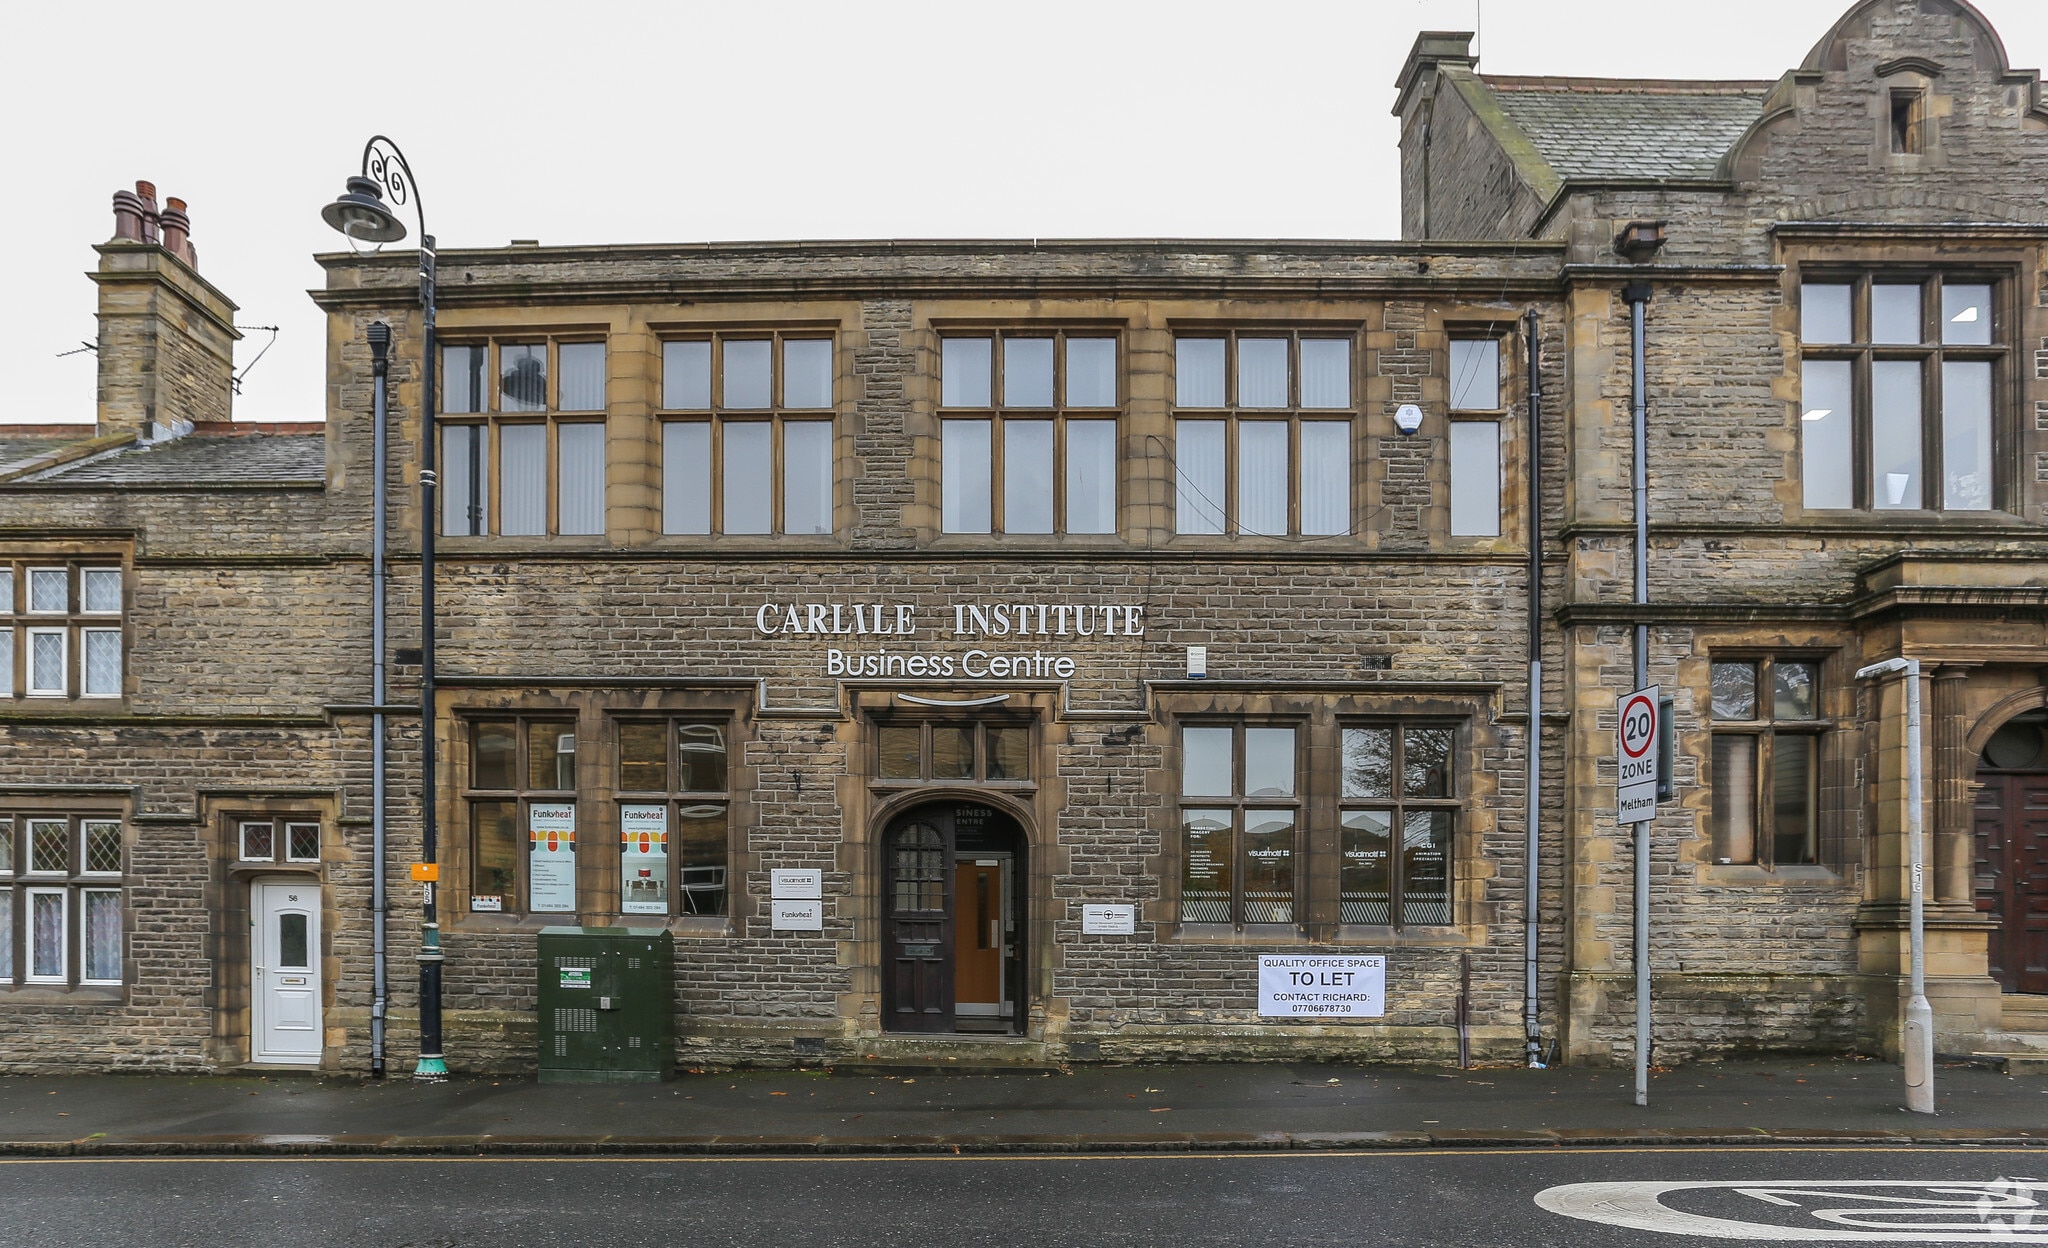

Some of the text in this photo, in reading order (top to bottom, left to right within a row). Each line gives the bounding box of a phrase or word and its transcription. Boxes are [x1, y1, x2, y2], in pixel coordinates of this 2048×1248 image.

[756, 603, 1145, 636] CARLILE INSTITUTE
[827, 649, 1076, 678] Business Centre
[1626, 712, 1650, 741] 20
[1621, 759, 1652, 779] ZONE
[1620, 797, 1653, 811] Meltham
[533, 810, 571, 818] Funkyheat
[625, 811, 663, 819] Funkyheat
[956, 809, 992, 817] SINESS
[1264, 959, 1380, 968] QUALITY OFFICE SPACE
[1289, 972, 1354, 986] TO LET
[1273, 993, 1370, 1001] CONTACT RICHARD:
[1292, 1004, 1351, 1012] 07706678730
